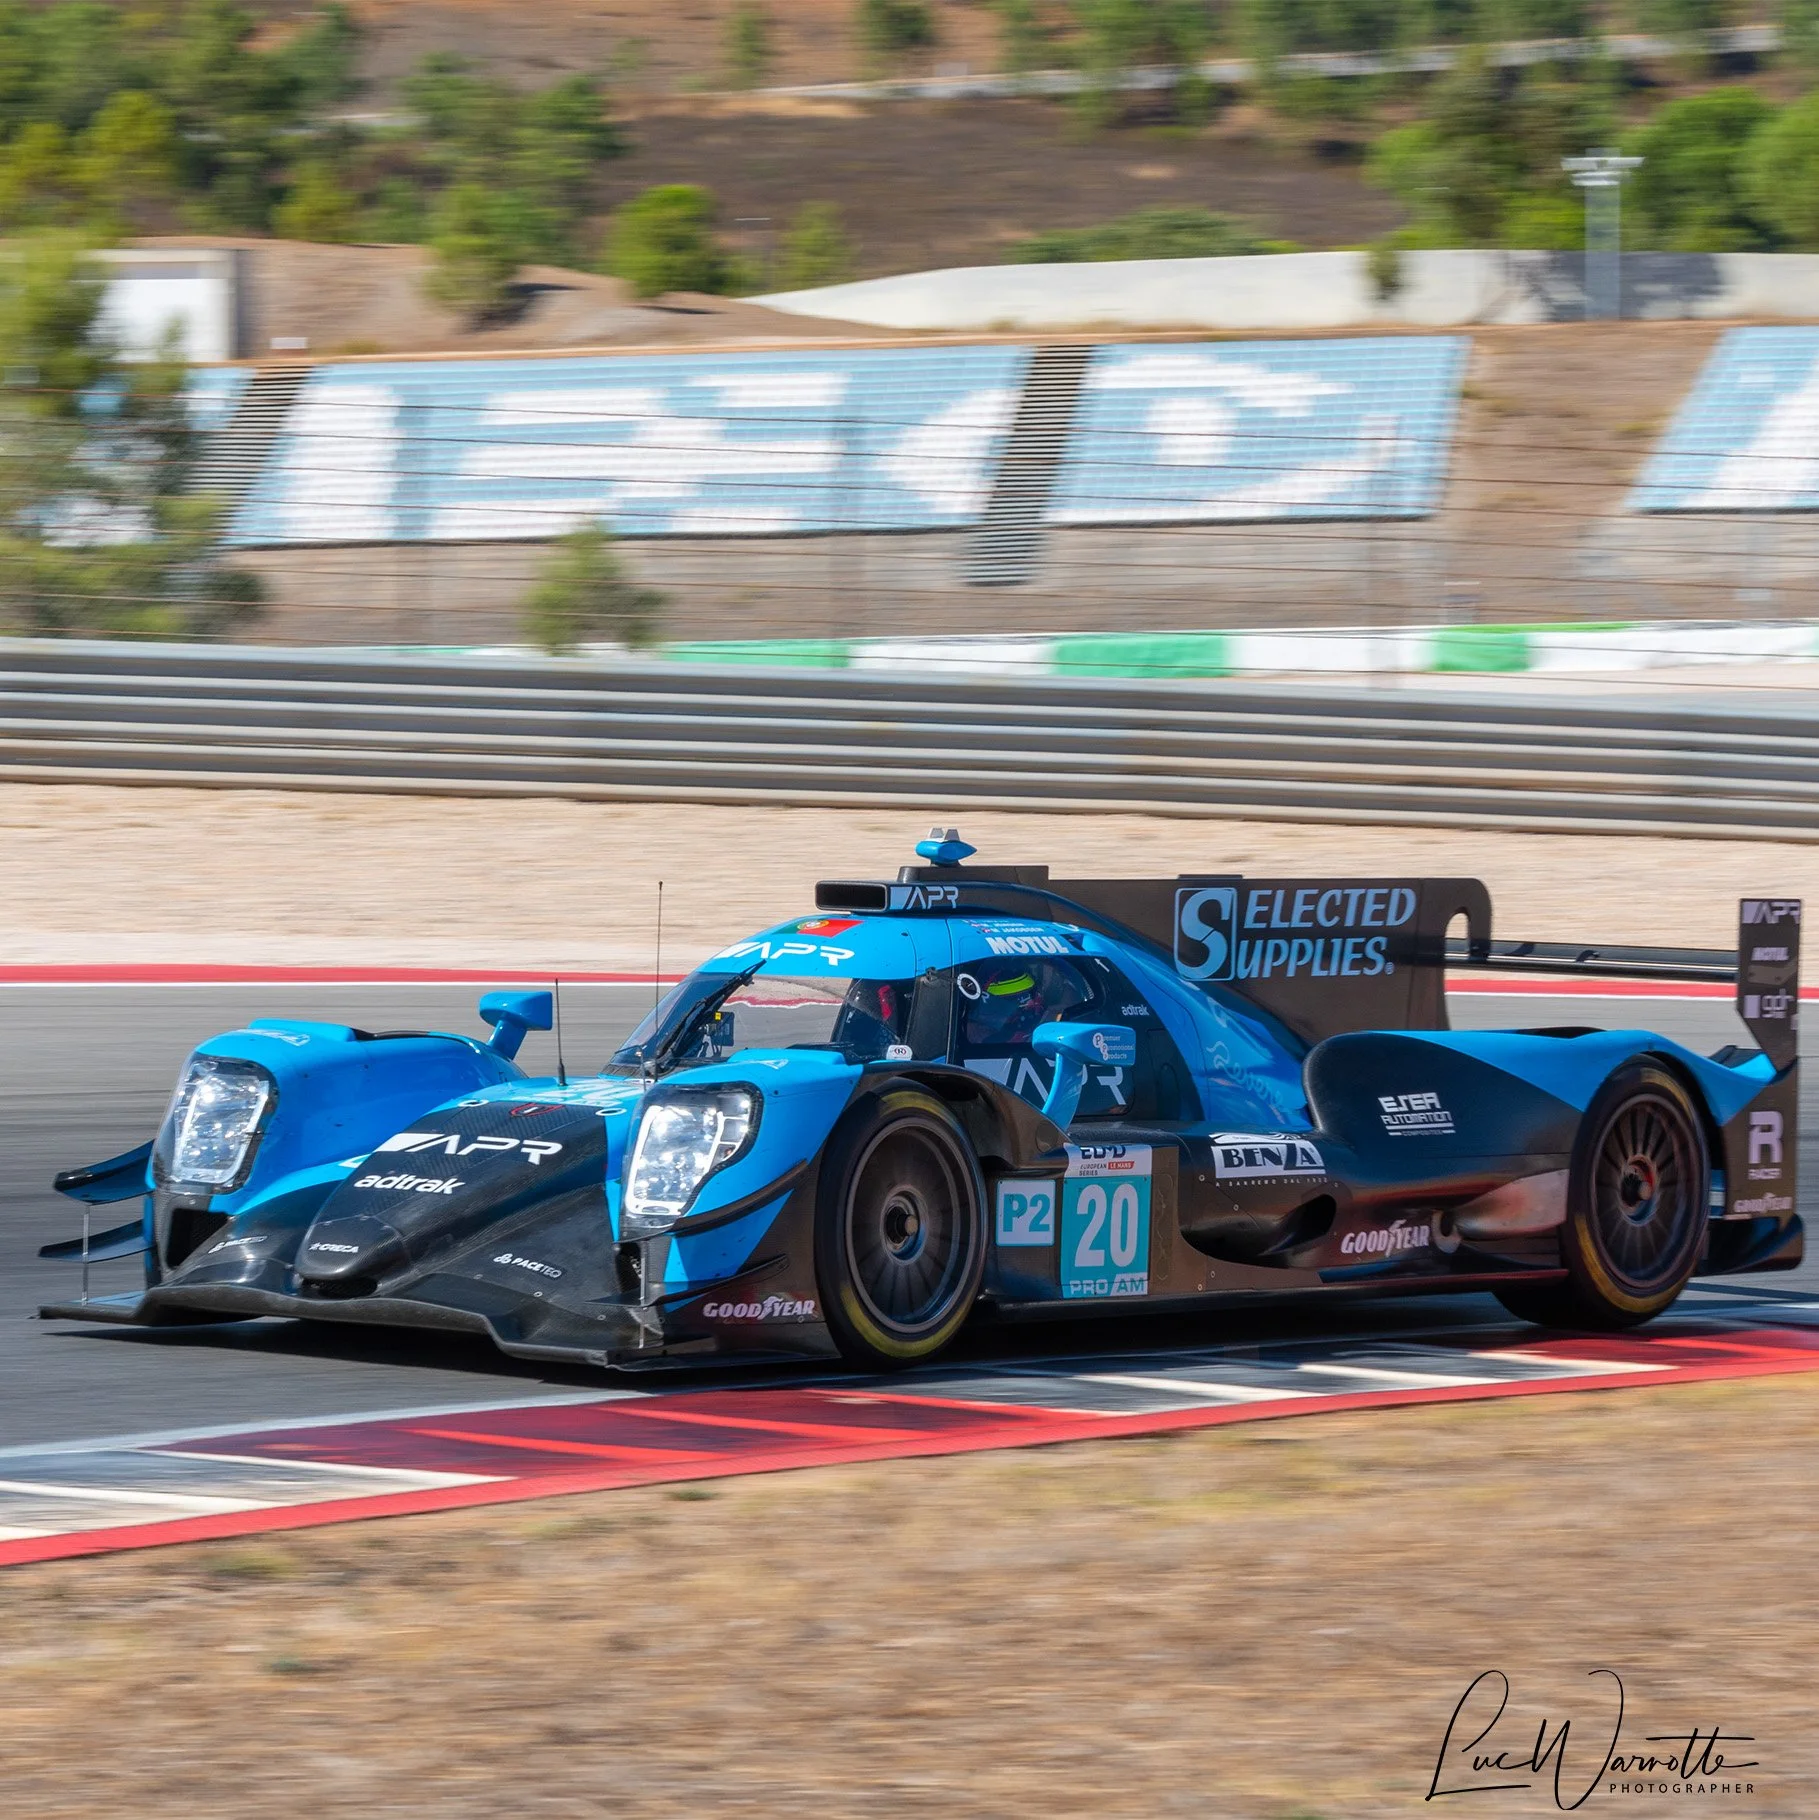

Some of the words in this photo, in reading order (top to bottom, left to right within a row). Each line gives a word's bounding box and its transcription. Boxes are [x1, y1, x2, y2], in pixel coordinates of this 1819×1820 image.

[906, 886, 959, 910] APR
[733, 941, 855, 966] APR
[985, 936, 1069, 954] MOTUL
[1121, 1003, 1150, 1016] adtrak
[1380, 1111, 1453, 1124] AUTOMATION
[404, 1134, 563, 1165] APR
[1748, 1111, 1783, 1164] R
[354, 1173, 466, 1195] adtrak
[1002, 1193, 1050, 1233] P2
[1074, 1183, 1139, 1268] 20
[1340, 1219, 1431, 1257] GOODYEAR
[1070, 1279, 1109, 1295] PRO
[1117, 1276, 1144, 1293] AM
[702, 1295, 816, 1320] GOODYEAR
